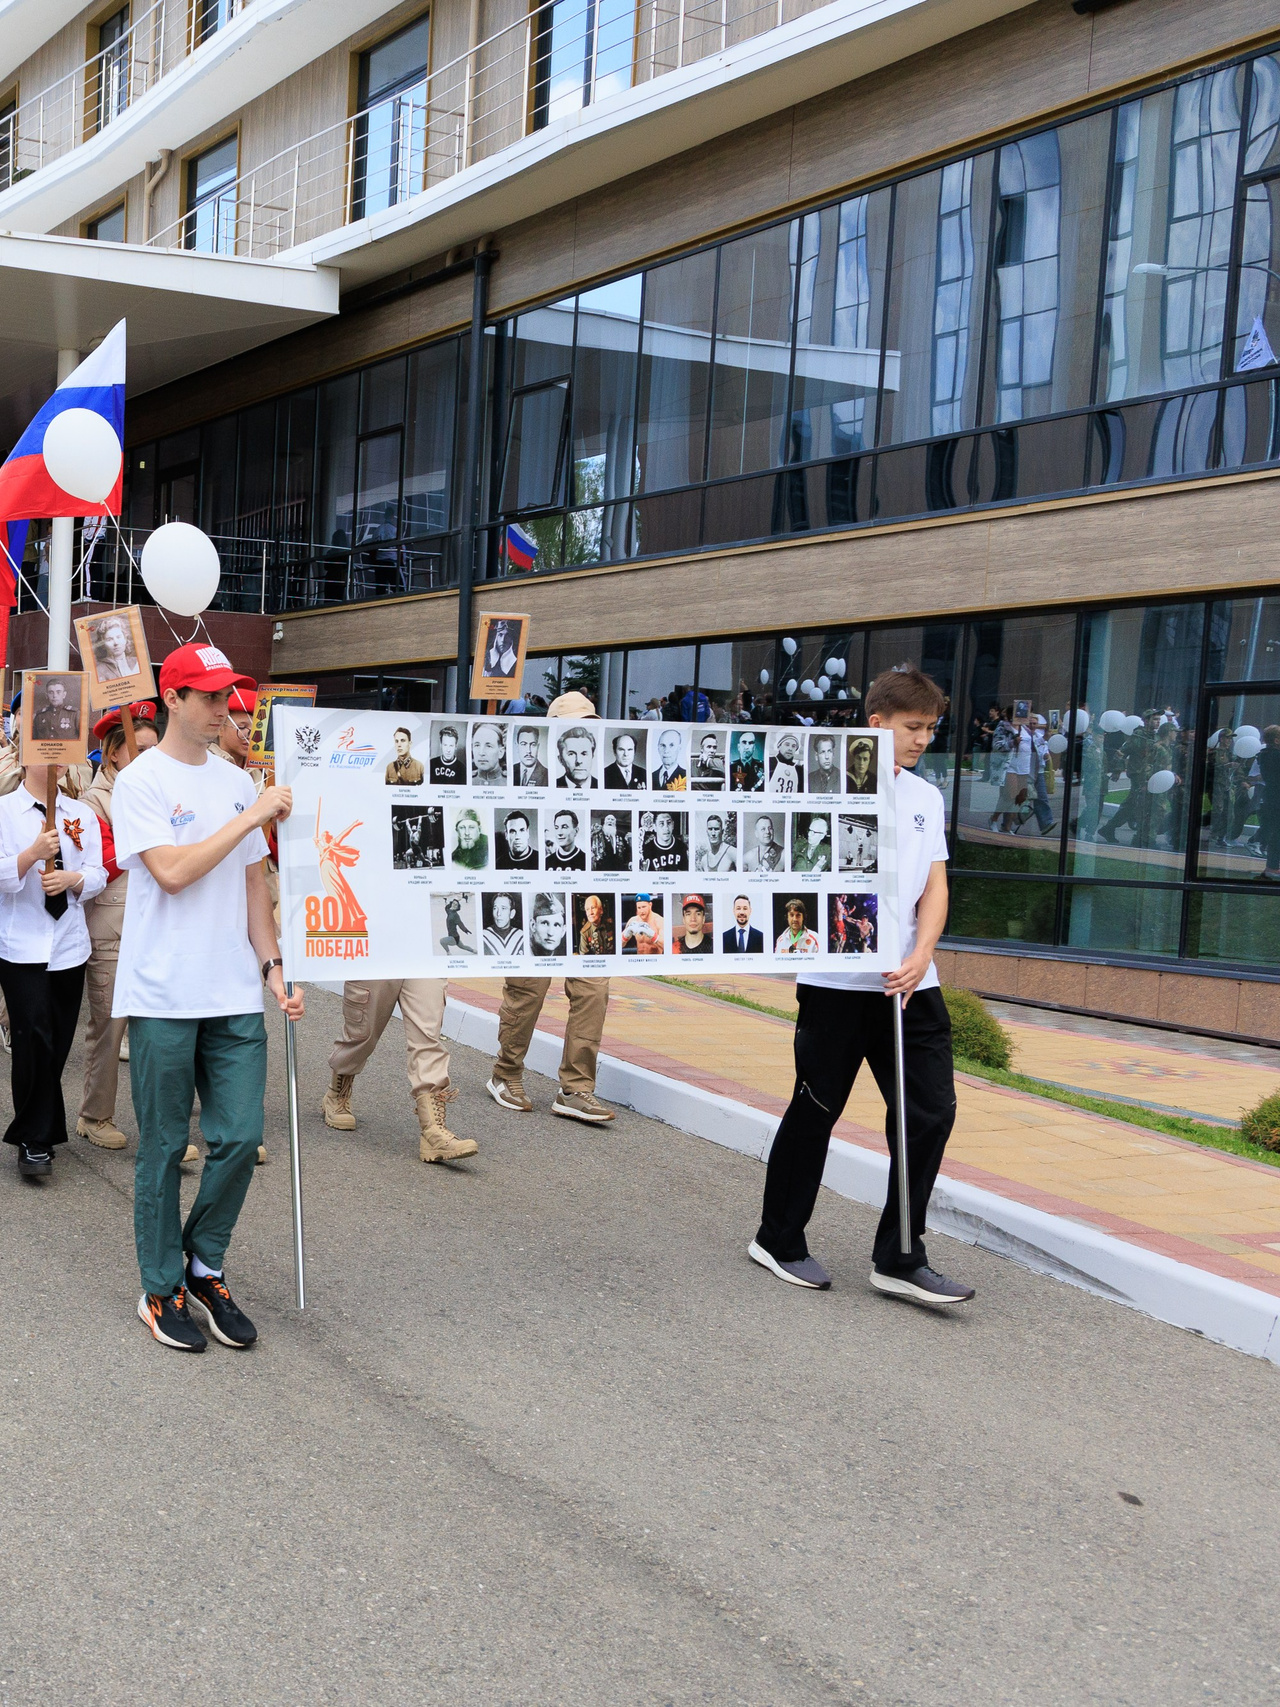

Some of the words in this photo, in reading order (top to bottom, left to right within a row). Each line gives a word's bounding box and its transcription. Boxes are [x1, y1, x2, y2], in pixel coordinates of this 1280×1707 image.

[330, 753, 346, 764] ЮГ
[348, 755, 375, 767] Спорт
[305, 895, 339, 932] 80
[305, 939, 368, 960] ПОБЕДА!
